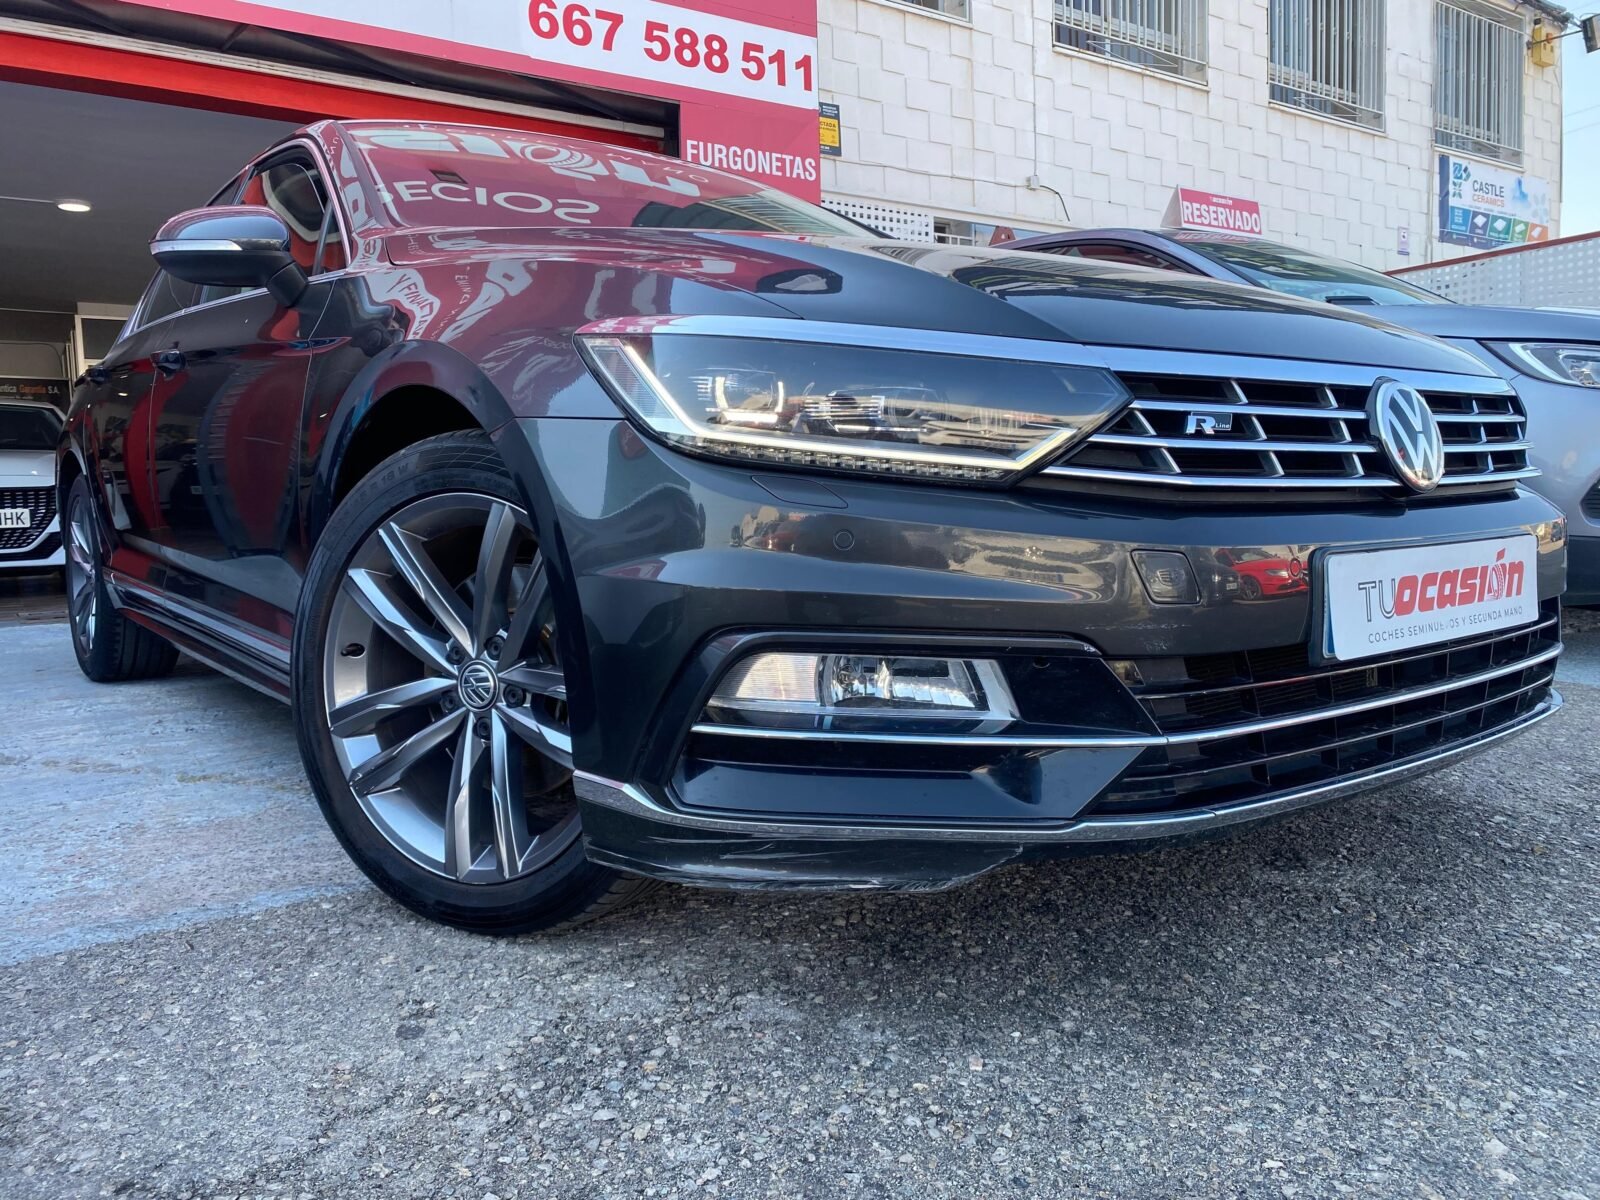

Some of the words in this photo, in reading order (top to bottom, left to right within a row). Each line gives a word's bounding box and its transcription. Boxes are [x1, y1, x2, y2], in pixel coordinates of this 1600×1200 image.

[527, 0, 624, 51] 667
[643, 20, 729, 74] 588
[741, 41, 813, 92] 511
[686, 139, 817, 182] FURGONETAS
[1472, 179, 1505, 198] CASTLE
[1472, 193, 1505, 208] CERAMICS
[1182, 200, 1261, 233] RESERVADO
[1185, 415, 1215, 435] R
[0, 511, 26, 526] HK
[1368, 626, 1405, 644] COCHES
[1407, 617, 1460, 637] SEMINUEOS
[1461, 616, 1467, 626] Y
[1469, 609, 1502, 623] SEGUNDA
[1504, 605, 1523, 617] MANO
